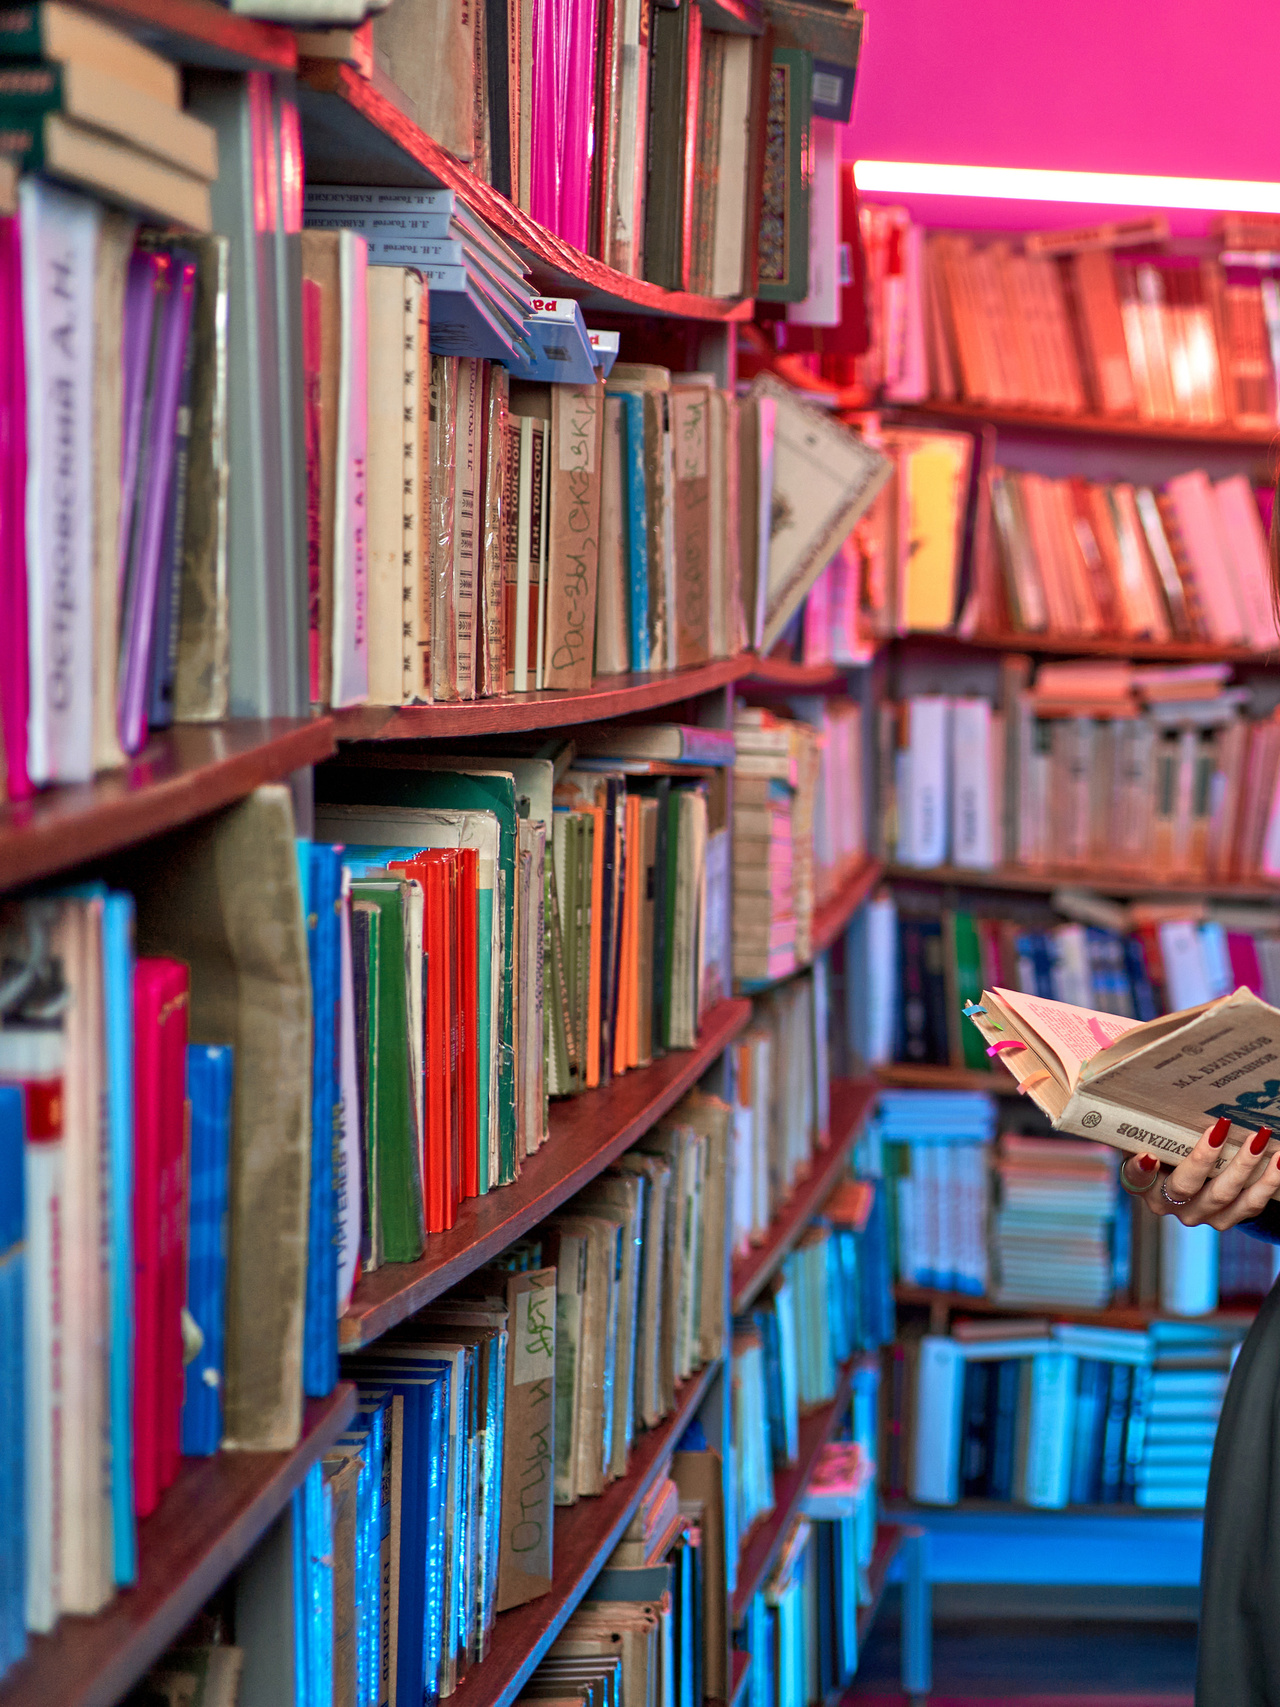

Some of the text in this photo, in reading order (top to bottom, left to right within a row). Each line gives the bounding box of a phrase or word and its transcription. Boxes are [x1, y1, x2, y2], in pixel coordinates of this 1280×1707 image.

[378, 194, 412, 204] Толстой
[372, 218, 406, 228] Толстой
[383, 244, 417, 254] Толстой
[510, 434, 520, 555] Л.Н. ТОЛСТОЙ
[532, 437, 542, 556] Л.Н. ТОЛСТОЙ
[1198, 1036, 1274, 1076] БУЛГАКОВ
[1208, 1053, 1279, 1089] ИЗБРАННОЕ
[1116, 1122, 1194, 1158] БУЛГАКОВ
